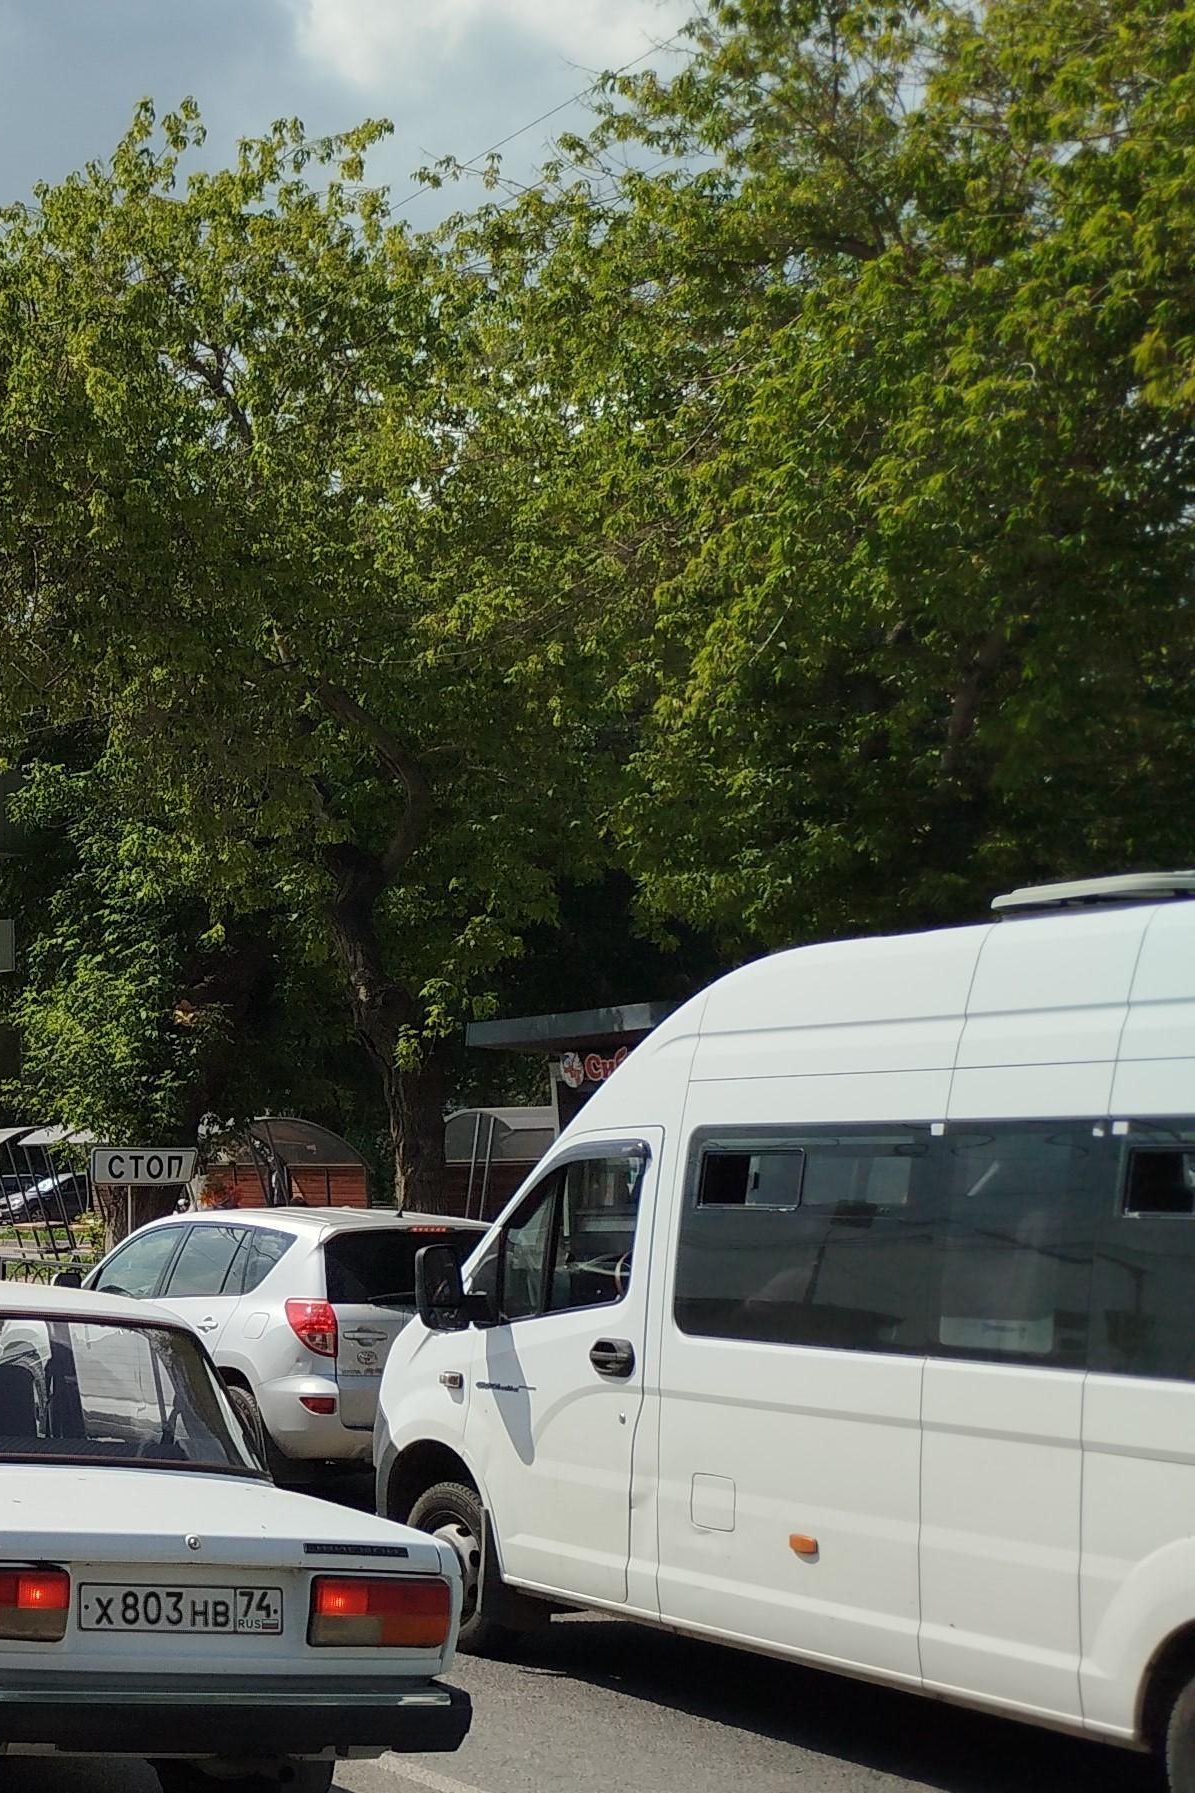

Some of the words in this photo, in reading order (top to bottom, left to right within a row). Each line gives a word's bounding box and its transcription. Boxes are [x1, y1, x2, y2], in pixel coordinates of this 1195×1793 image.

[108, 1154, 184, 1180] СТОП
[238, 1590, 272, 1619] 74
[238, 1619, 261, 1629] RUS
